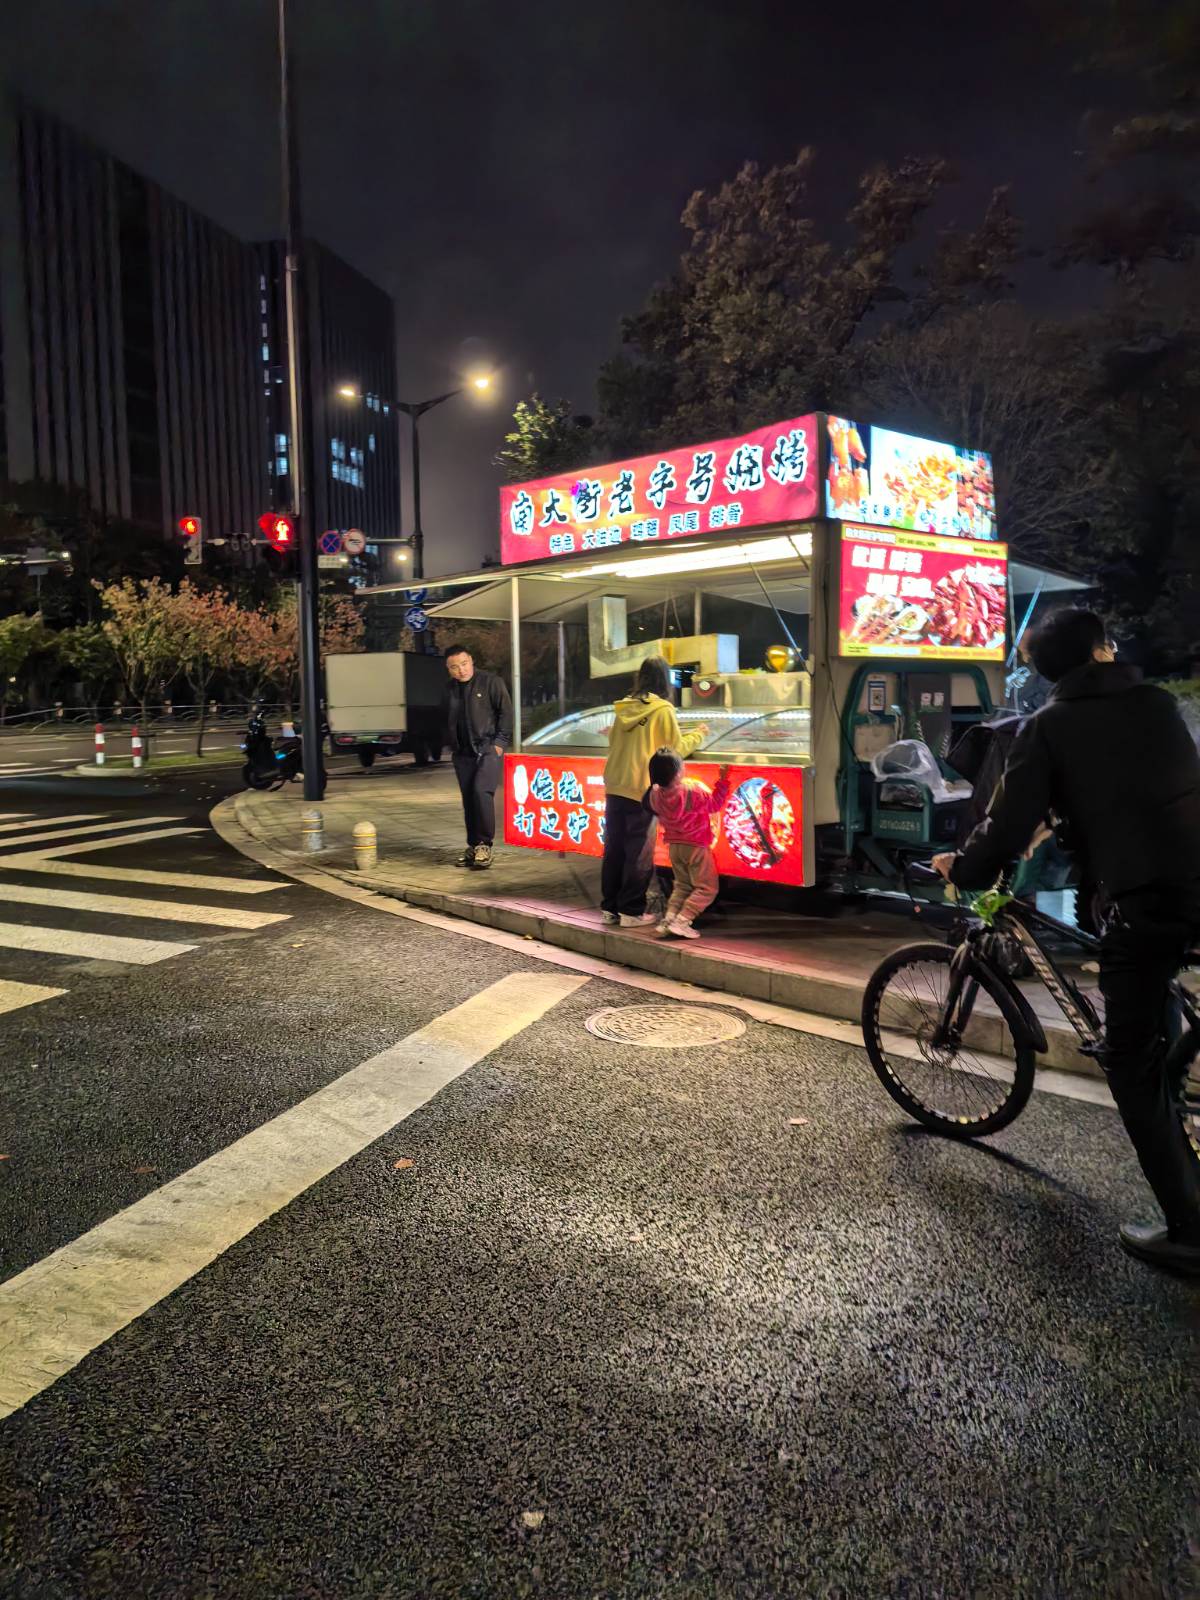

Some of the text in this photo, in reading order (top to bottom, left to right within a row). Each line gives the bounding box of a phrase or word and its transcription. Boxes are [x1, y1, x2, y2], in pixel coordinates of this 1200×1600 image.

[509, 430, 808, 536] 南大街老字号烧烤
[709, 502, 743, 528] 排骨
[531, 768, 584, 805] 传统
[514, 804, 606, 844] 打边炉
